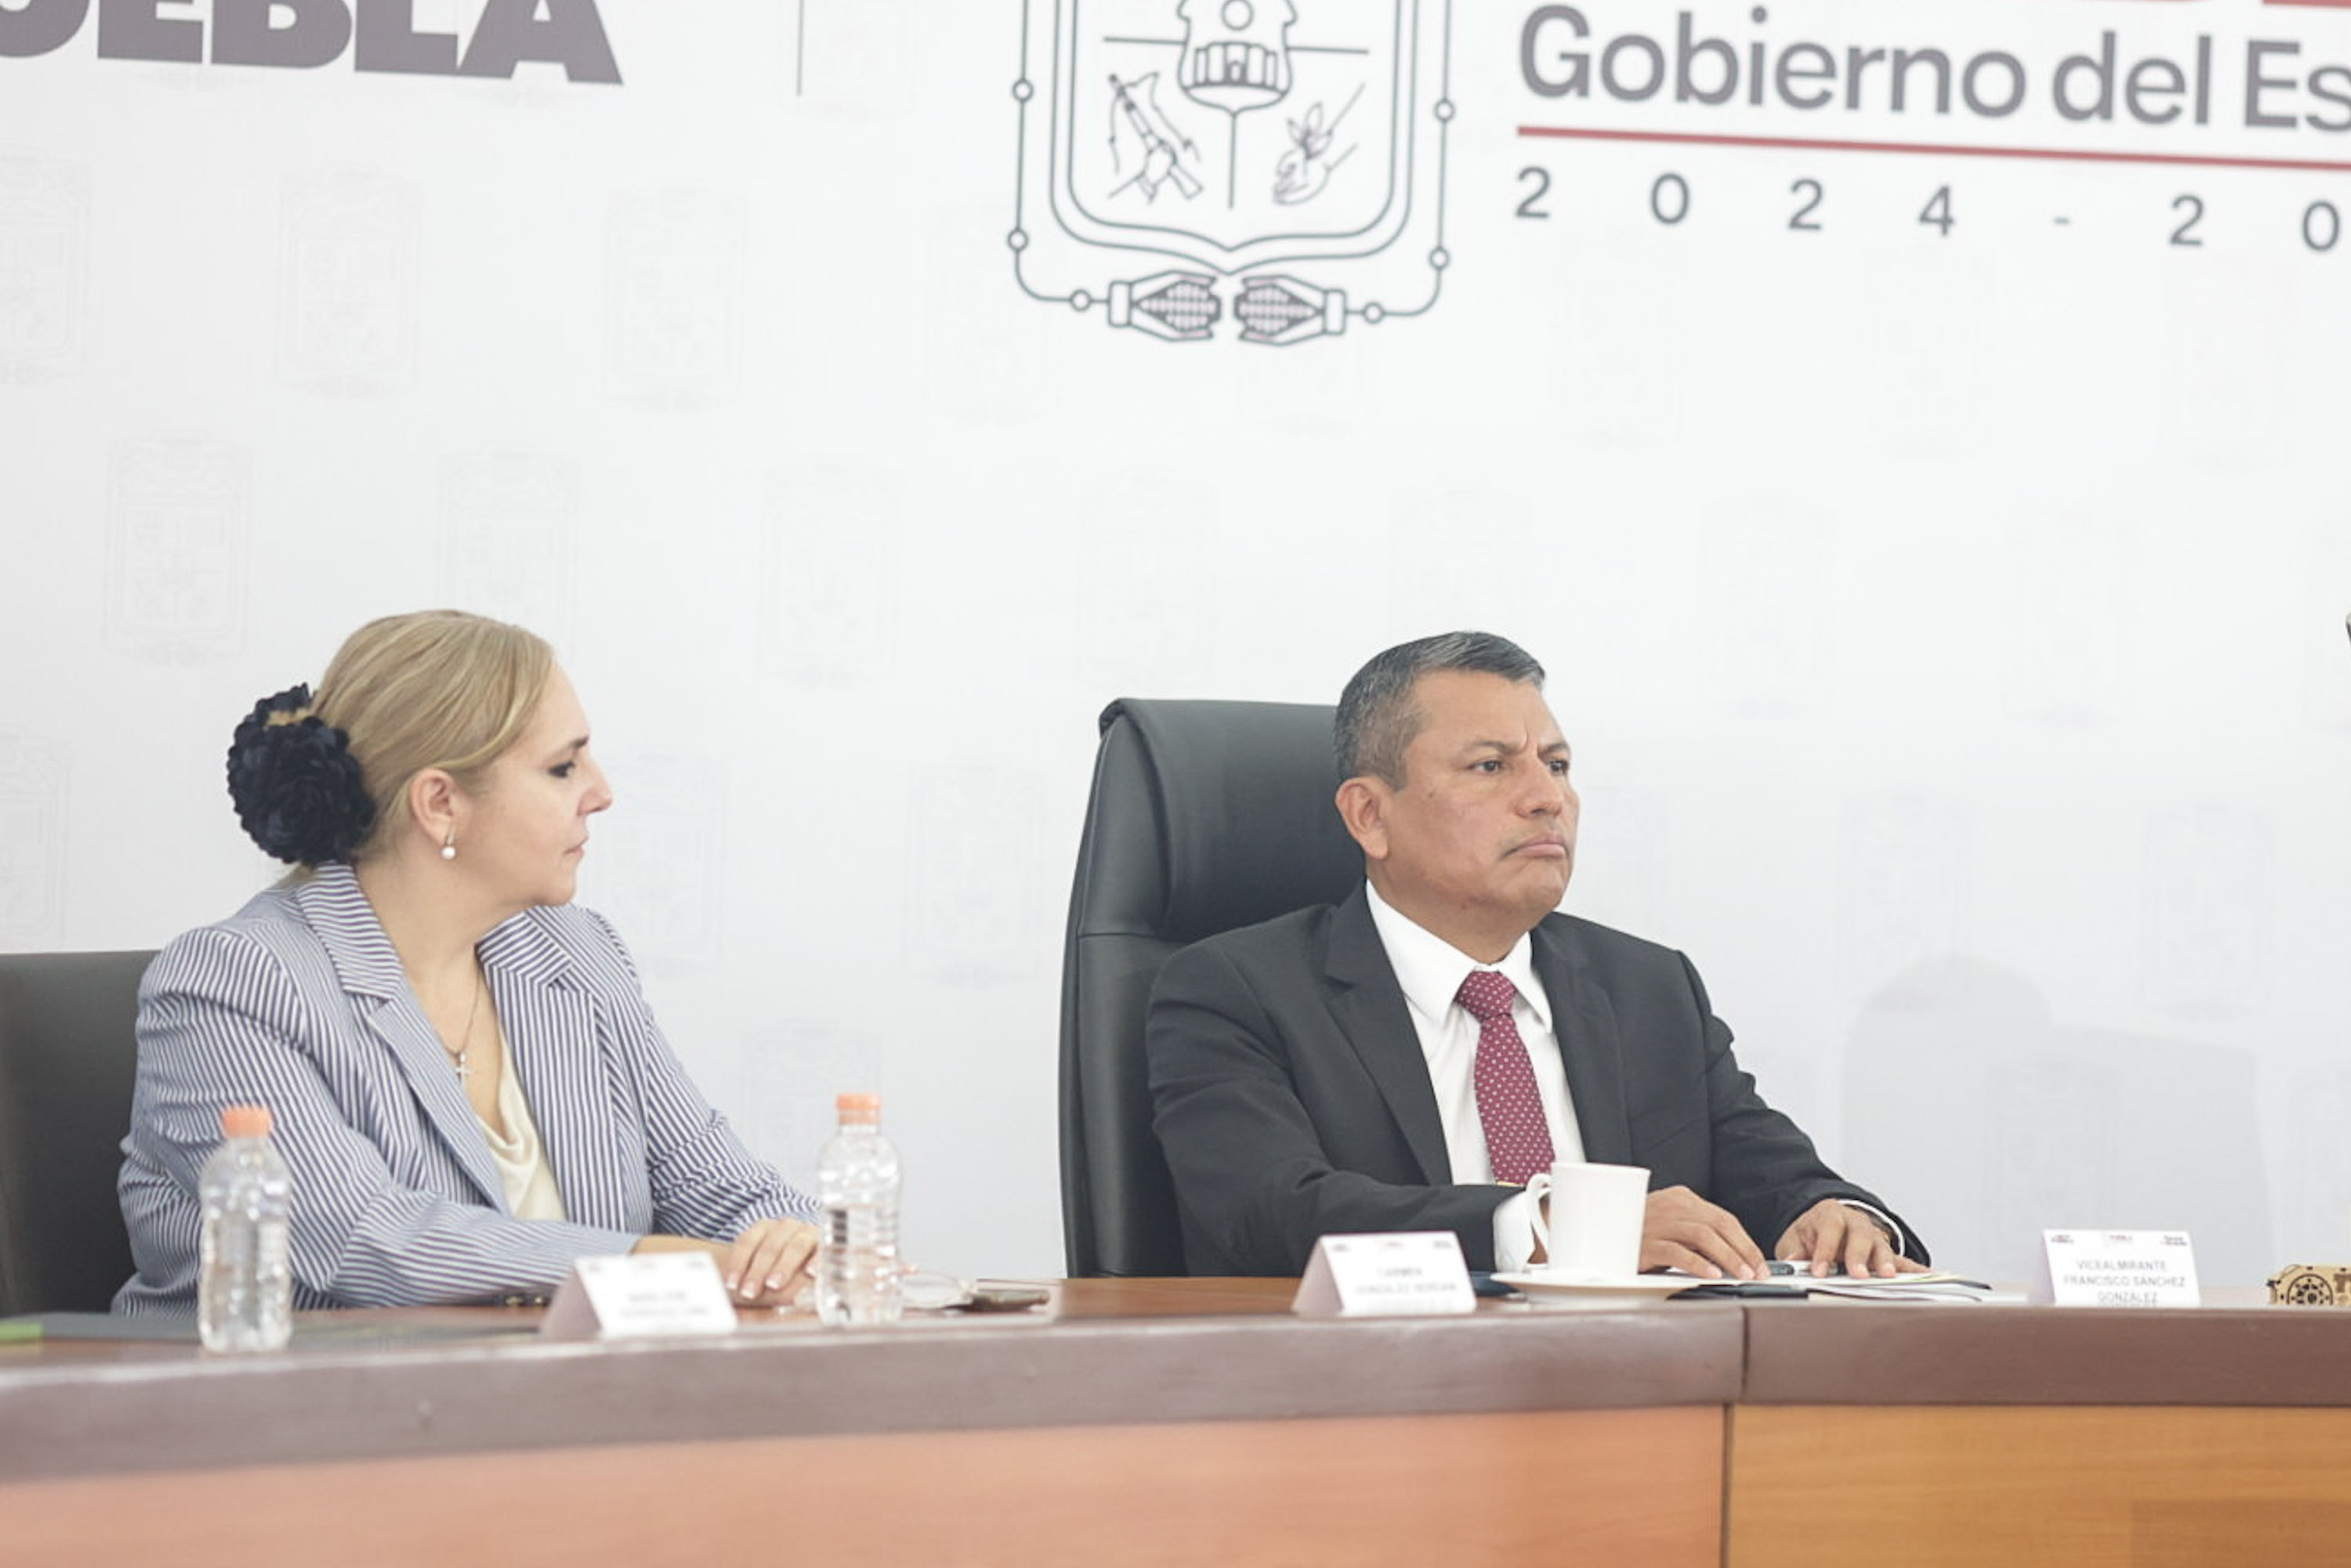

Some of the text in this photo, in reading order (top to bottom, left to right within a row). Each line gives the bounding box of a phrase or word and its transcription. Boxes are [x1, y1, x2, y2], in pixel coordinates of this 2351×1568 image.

[1520, 4, 2027, 118] Gobierno
[2052, 31, 2213, 126] del
[2077, 1260, 2168, 1272] VICEALMIRANTE
[2063, 1274, 2130, 1287] FRANCISCO
